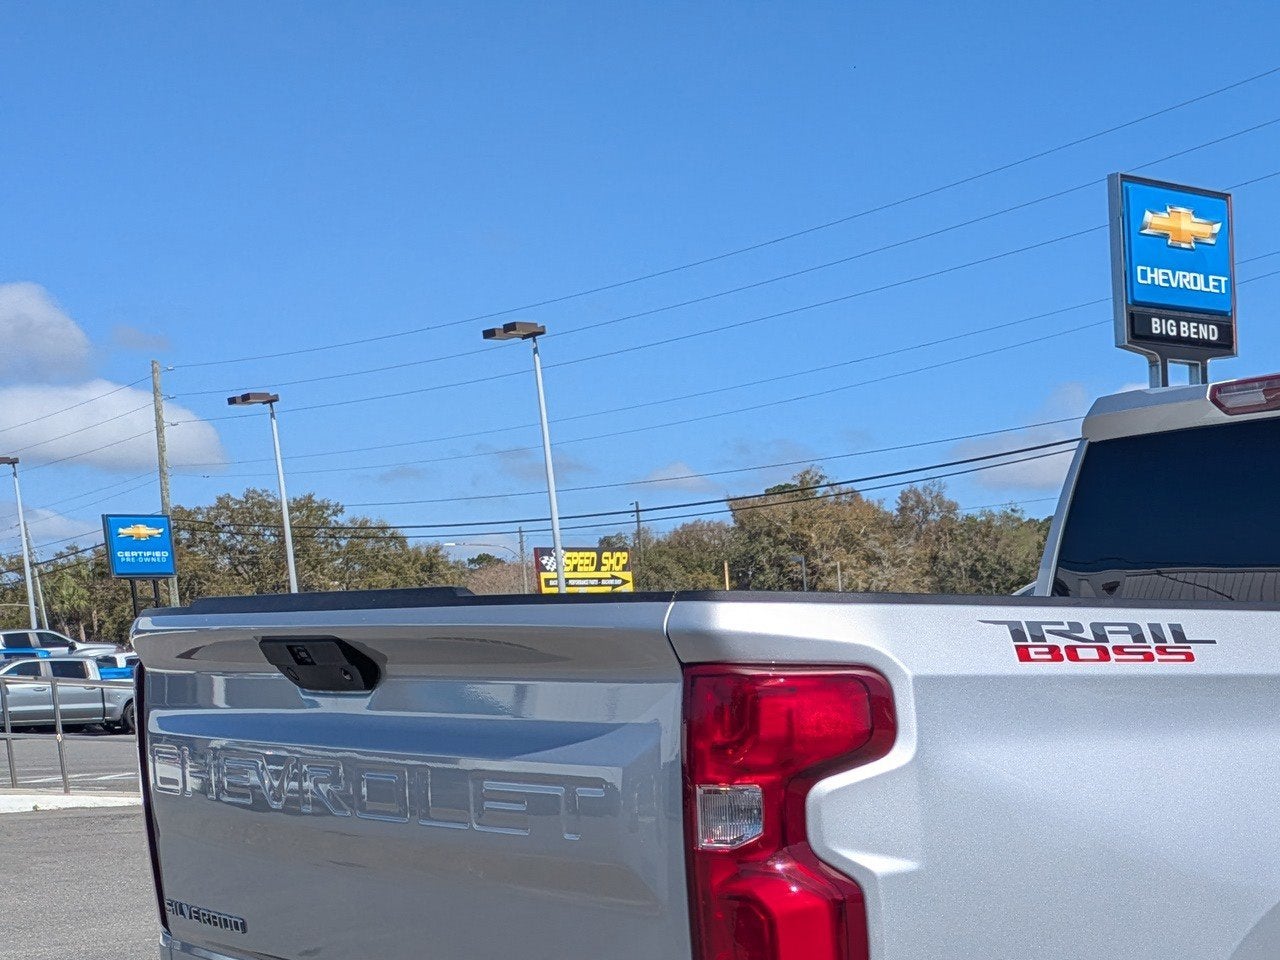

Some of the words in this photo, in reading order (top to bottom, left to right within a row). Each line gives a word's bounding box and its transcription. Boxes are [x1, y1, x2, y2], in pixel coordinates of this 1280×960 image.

[1137, 265, 1228, 294] CHEVROLET
[1151, 317, 1177, 337] BIG
[1180, 321, 1219, 341] BEND
[564, 551, 597, 572] SPEED
[601, 551, 628, 572] SHOP
[977, 619, 1217, 645] TRAIL
[1014, 644, 1195, 663] BOSS
[152, 743, 606, 841] CHEVROLET
[164, 899, 248, 934] SILVERADO
